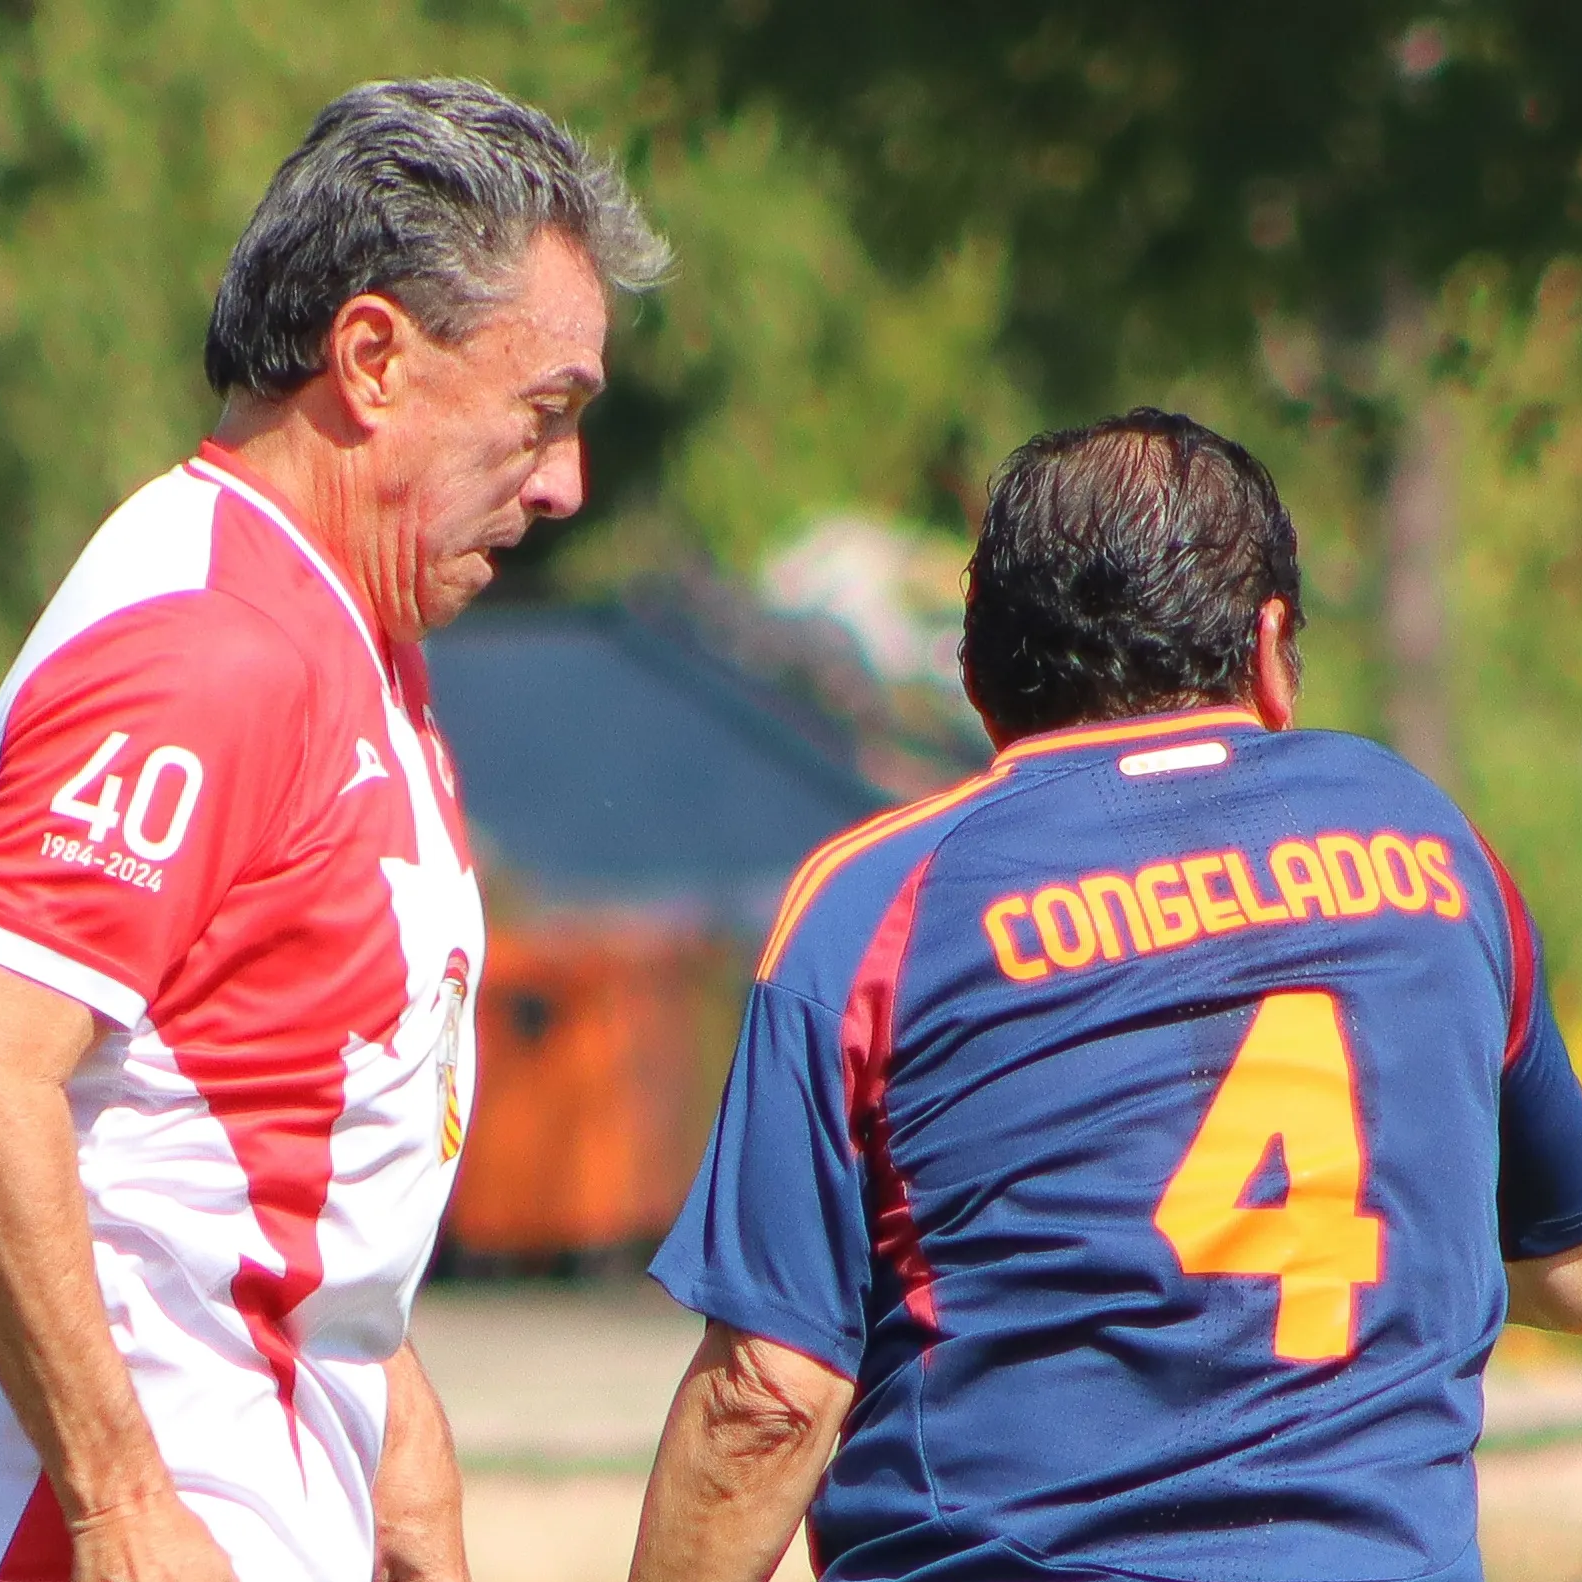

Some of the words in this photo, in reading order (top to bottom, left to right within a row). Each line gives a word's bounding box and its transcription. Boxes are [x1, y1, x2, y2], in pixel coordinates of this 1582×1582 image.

[40, 831, 163, 893] 1984-2024
[49, 730, 204, 861] 40
[981, 832, 1466, 983] CONGELADOS
[1151, 987, 1386, 1362] 4
